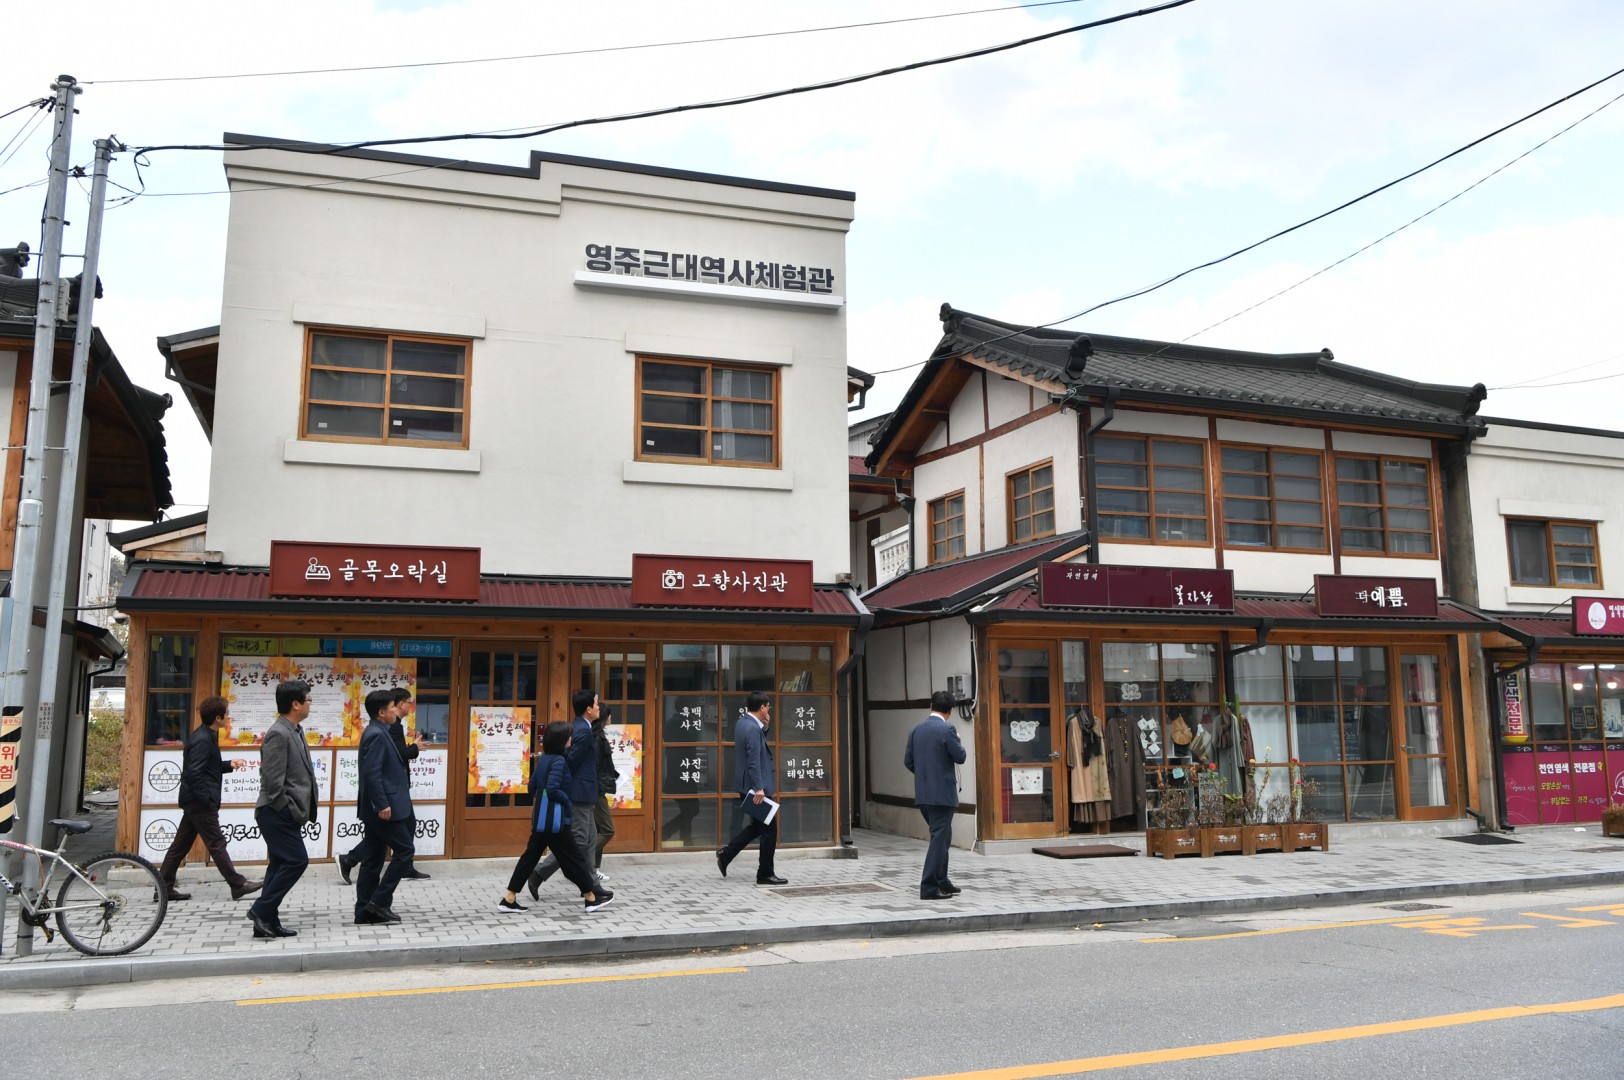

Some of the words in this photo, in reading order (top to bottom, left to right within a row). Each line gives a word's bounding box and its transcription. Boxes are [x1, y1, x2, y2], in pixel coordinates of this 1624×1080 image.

[585, 243, 835, 294] 영주근대역사체험관
[338, 558, 448, 585] 골목오락실
[692, 569, 789, 594] 고향사진관
[680, 706, 702, 718] 흑백
[794, 706, 816, 718] 장수
[680, 719, 702, 731] 사진
[794, 719, 816, 731] 사진
[0, 745, 15, 780] 위험
[680, 758, 702, 770] 사진
[680, 771, 701, 783] 복원
